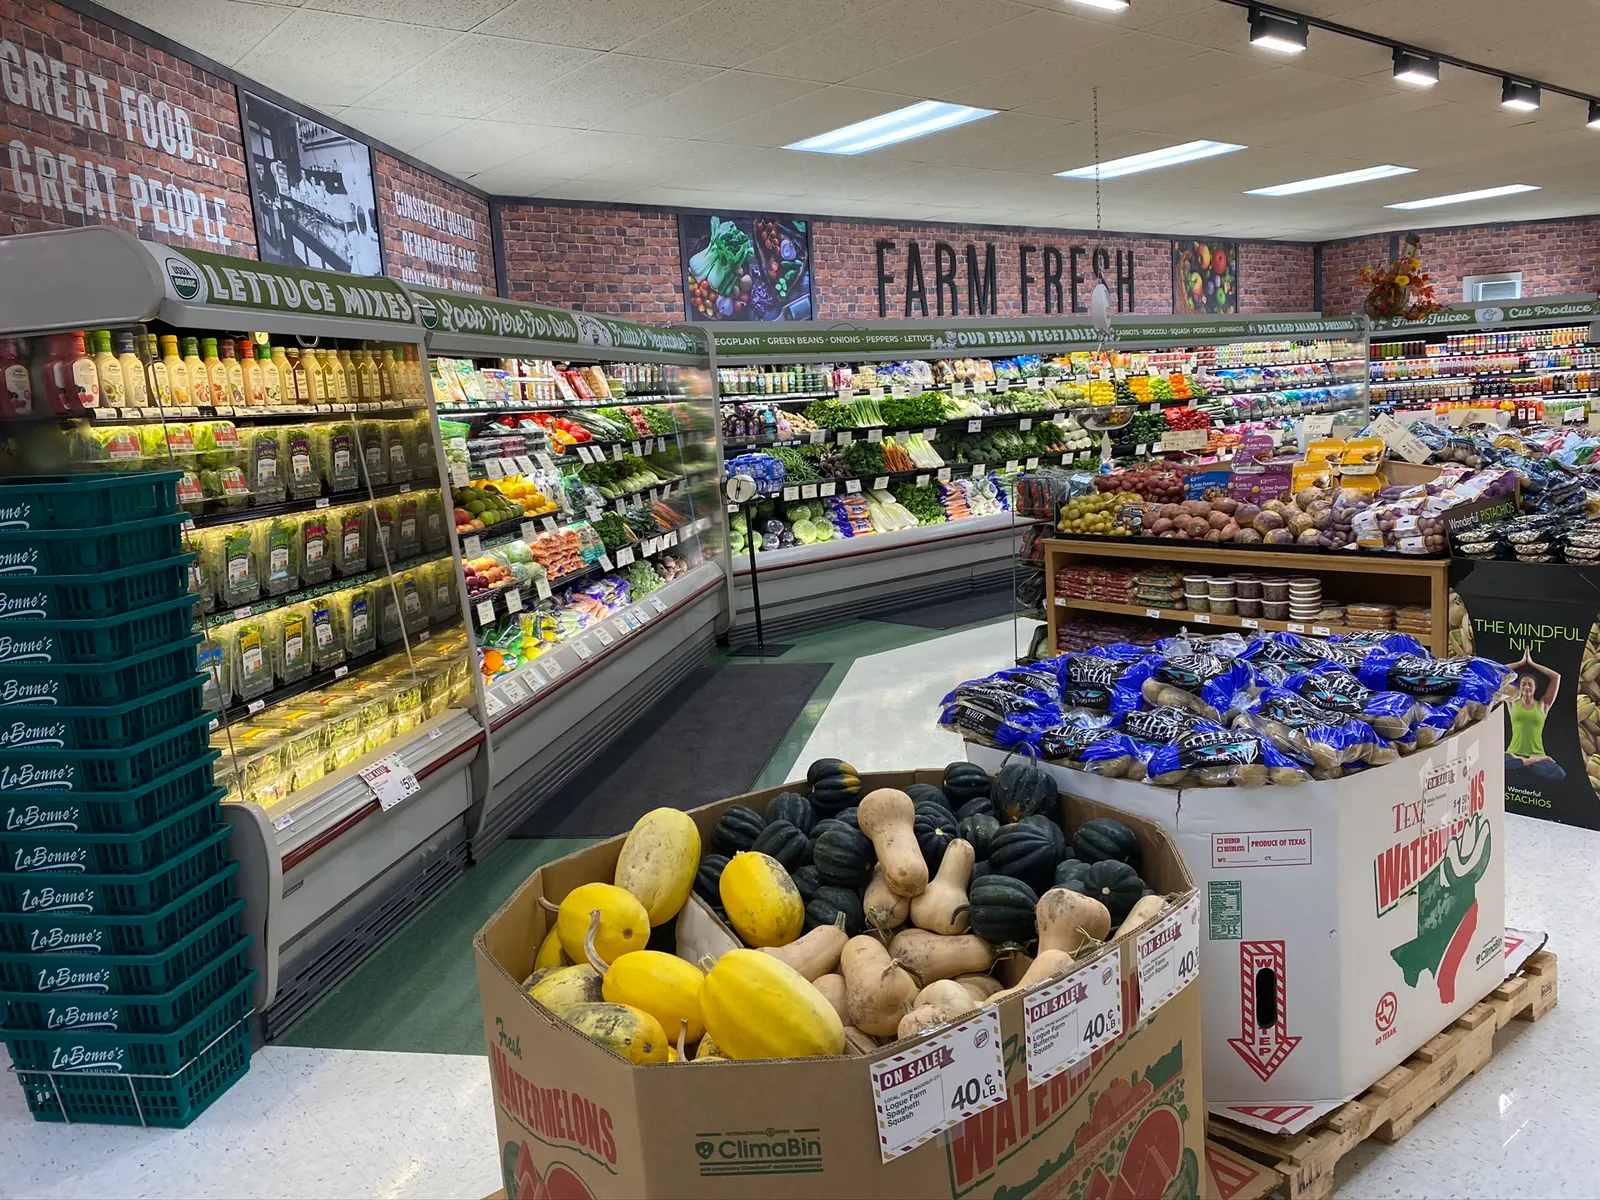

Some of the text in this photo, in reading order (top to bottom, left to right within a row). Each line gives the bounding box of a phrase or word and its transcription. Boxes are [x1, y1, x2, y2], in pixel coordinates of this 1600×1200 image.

[1, 39, 109, 134] GREAT
[8, 140, 231, 246] GREAT PEOPLE
[394, 190, 475, 240] CONSISTENT QUALITY
[402, 230, 477, 273] REMARKABLE CARE
[171, 265, 191, 277] USDA
[174, 277, 197, 287] ORGANIC
[875, 238, 1135, 318] FARM FRESH
[202, 264, 412, 321] LETTUCE MIXES
[436, 298, 577, 339] Look Here For Our
[1257, 323, 1295, 333] PACKAGED
[1296, 322, 1319, 332] SALADS
[1325, 320, 1354, 330] DRESSING
[1427, 313, 1471, 326] Juices
[1508, 307, 1533, 318] Cut
[1534, 304, 1592, 316] Produce
[607, 321, 641, 347] Fruits
[644, 328, 687, 352] Vegetables
[715, 333, 935, 347] EGGPLANT GREEN BEANS ONIONS PEPPERS LETTUCE
[958, 328, 1100, 345] OUR FRESH VEGETABLES
[1170, 327, 1190, 335] SQUASH
[1193, 326, 1216, 334] POTATOES
[1218, 325, 1245, 333] ASPARAGUS
[1449, 501, 1515, 530] Wonderful PISTACHIOS
[1474, 618, 1585, 642] THE MINDFUL
[1509, 637, 1546, 653] NUT
[964, 707, 987, 722] WHITE
[1, 764, 75, 790] LaBonne's
[1507, 785, 1542, 798] Wonderful
[6, 805, 79, 831] LaBonne's
[1251, 838, 1307, 848] PRODUCE OF TEXAS
[14, 846, 87, 872] LaBonne's
[22, 887, 95, 912] LaBonne's
[31, 928, 103, 953] LaBonne's
[1142, 924, 1177, 957] ON SALE!
[1178, 949, 1194, 978] 40
[38, 967, 111, 992] LaBonne's
[1033, 985, 1080, 1020] ON SALE!
[48, 1006, 119, 1030] LaBonne's
[1083, 1012, 1105, 1044] 40
[1105, 1018, 1116, 1032] LB
[496, 1016, 523, 1060] Fresh
[1032, 1021, 1066, 1042] Logue Farm
[1033, 1031, 1060, 1049] Butternut
[52, 1045, 124, 1069] LaBonne's
[1033, 1041, 1055, 1057] Squash
[884, 1071, 904, 1089] ON
[908, 1048, 944, 1079] SALE!
[490, 1040, 618, 1165] WATERMELONS
[885, 1088, 927, 1112] Logue Farm
[900, 1088, 914, 1098] FROM
[951, 1077, 981, 1111] 40
[984, 1073, 993, 1086] ¢
[982, 1084, 997, 1099] LB
[886, 1100, 921, 1120] Spaghetti
[887, 1111, 914, 1128] Squash
[718, 1137, 822, 1160] ClimaBin
